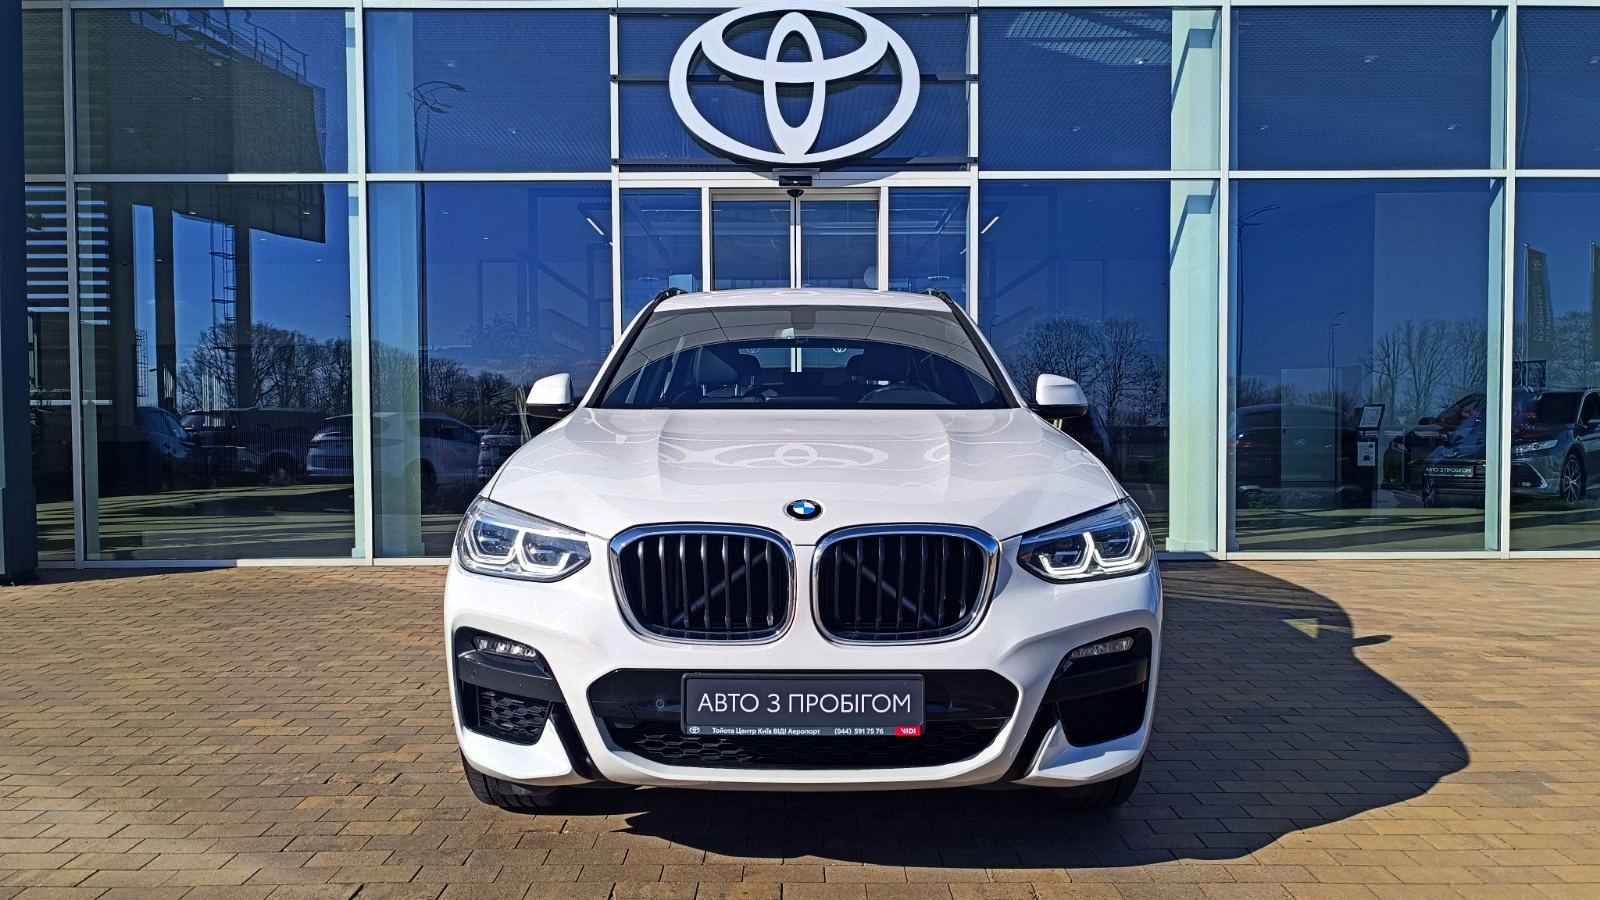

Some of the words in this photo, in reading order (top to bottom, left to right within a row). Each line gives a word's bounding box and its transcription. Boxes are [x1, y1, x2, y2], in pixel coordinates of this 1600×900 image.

[697, 693, 759, 713] АВТО
[788, 693, 911, 713] ПРОБІГОМ
[736, 727, 757, 736] Центр
[758, 727, 772, 735] Київ
[788, 728, 821, 736] Аеропорт
[834, 727, 852, 736] (044)
[900, 727, 917, 735] VIDI
